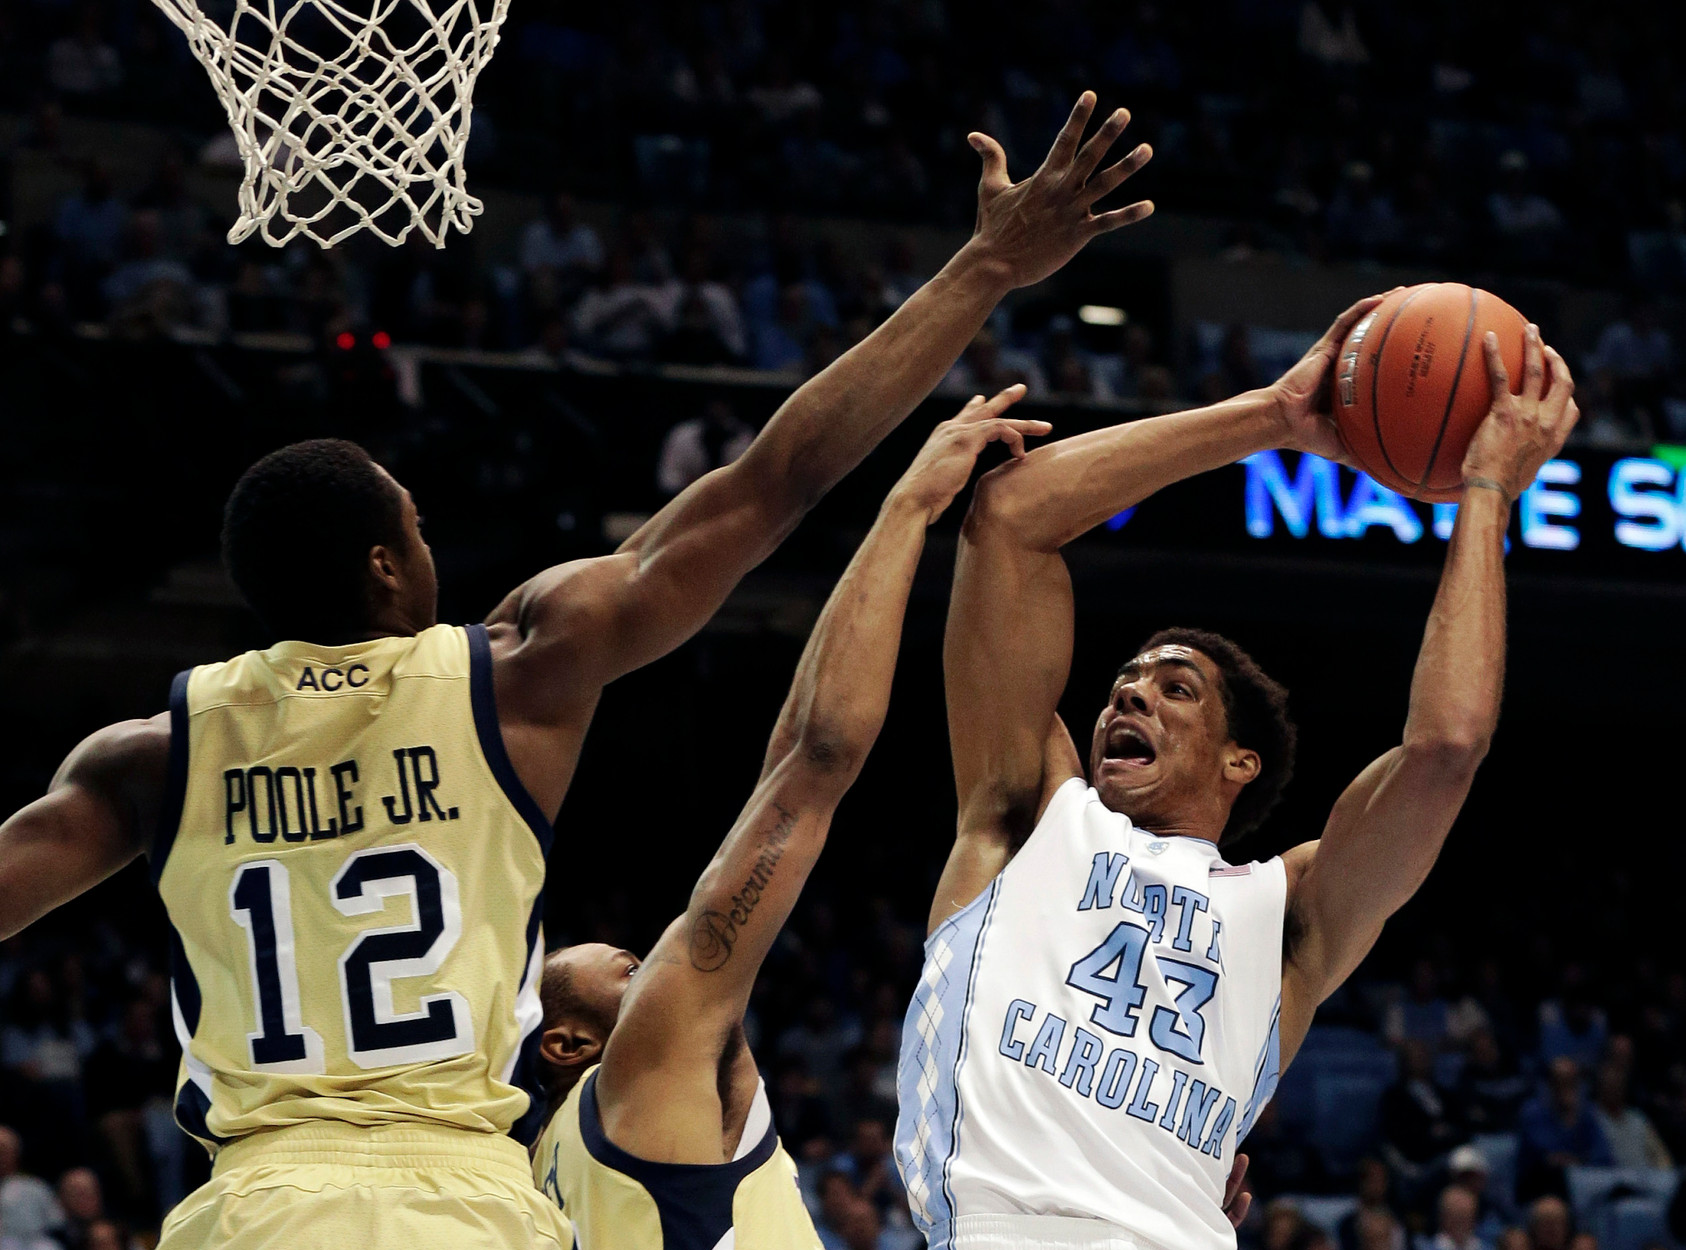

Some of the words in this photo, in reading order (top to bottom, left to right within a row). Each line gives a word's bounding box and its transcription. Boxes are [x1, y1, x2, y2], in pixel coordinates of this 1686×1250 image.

[1238, 448, 1581, 551] MAE
[1608, 457, 1686, 553] S
[296, 663, 370, 693] ACC
[223, 759, 365, 846] POOLE
[382, 745, 461, 826] JR.
[228, 843, 476, 1075] 12
[1065, 920, 1220, 1065] 43
[998, 998, 1237, 1160] CAROLINA
